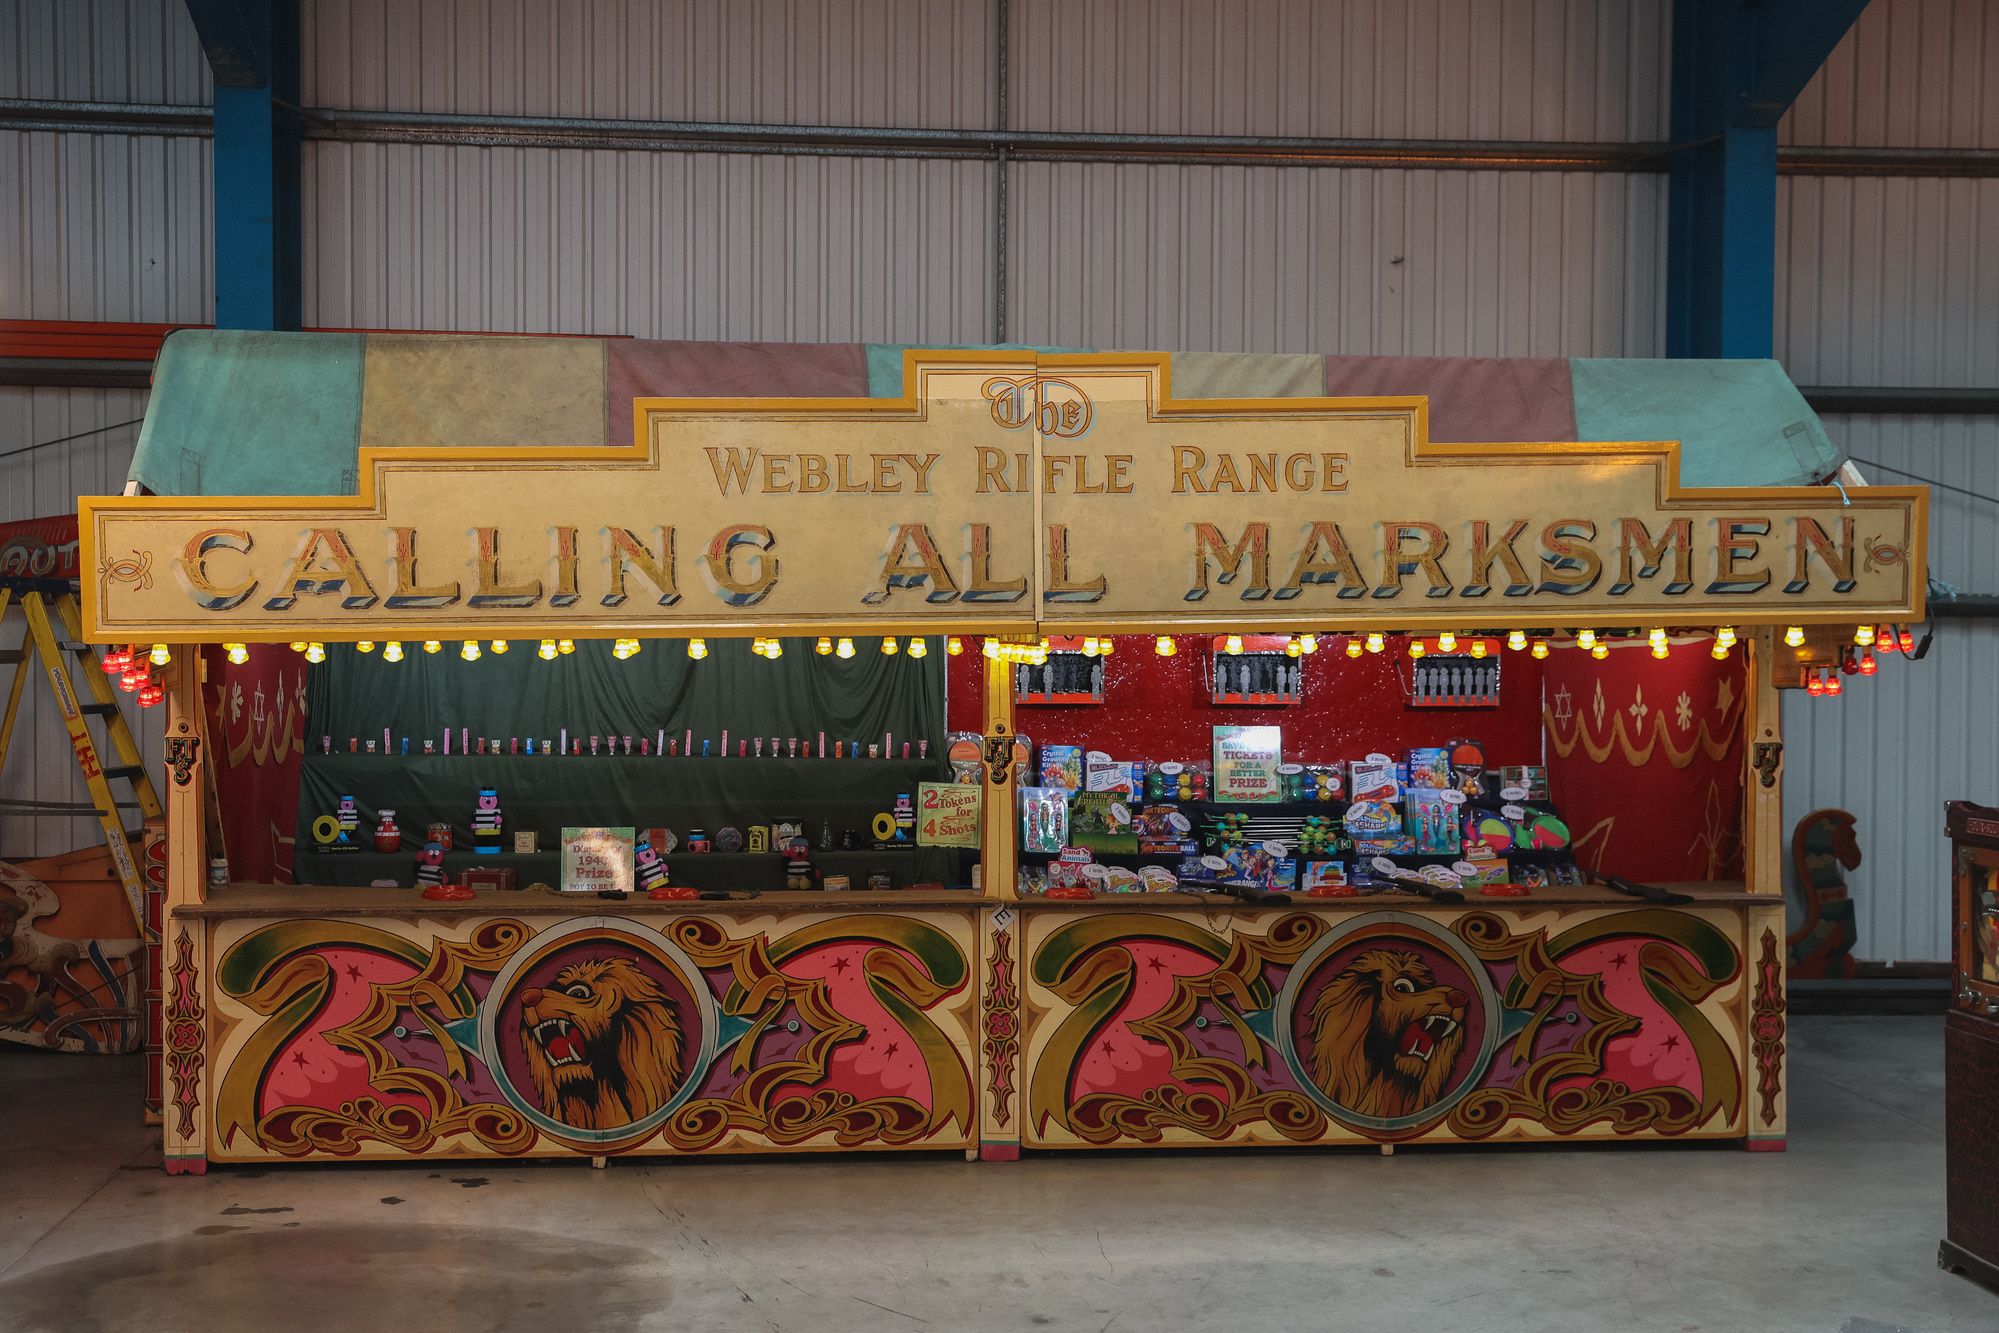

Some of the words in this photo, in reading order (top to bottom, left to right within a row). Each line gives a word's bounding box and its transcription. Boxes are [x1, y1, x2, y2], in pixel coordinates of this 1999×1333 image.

[980, 376, 1093, 438] The
[703, 446, 940, 496] WEBLEY
[974, 445, 1135, 494] RIFLE
[1170, 444, 1350, 494] RANGE
[175, 524, 781, 611] CALLING
[861, 521, 1107, 606] ALL
[1183, 516, 1858, 602] MARKSMEN
[1223, 751, 1273, 759] TICKETS
[1229, 778, 1268, 788] PRIZE
[923, 789, 938, 809] 2
[939, 794, 977, 809] Tokens
[956, 807, 973, 817] for
[923, 819, 937, 837] 4
[940, 823, 976, 836] Shots
